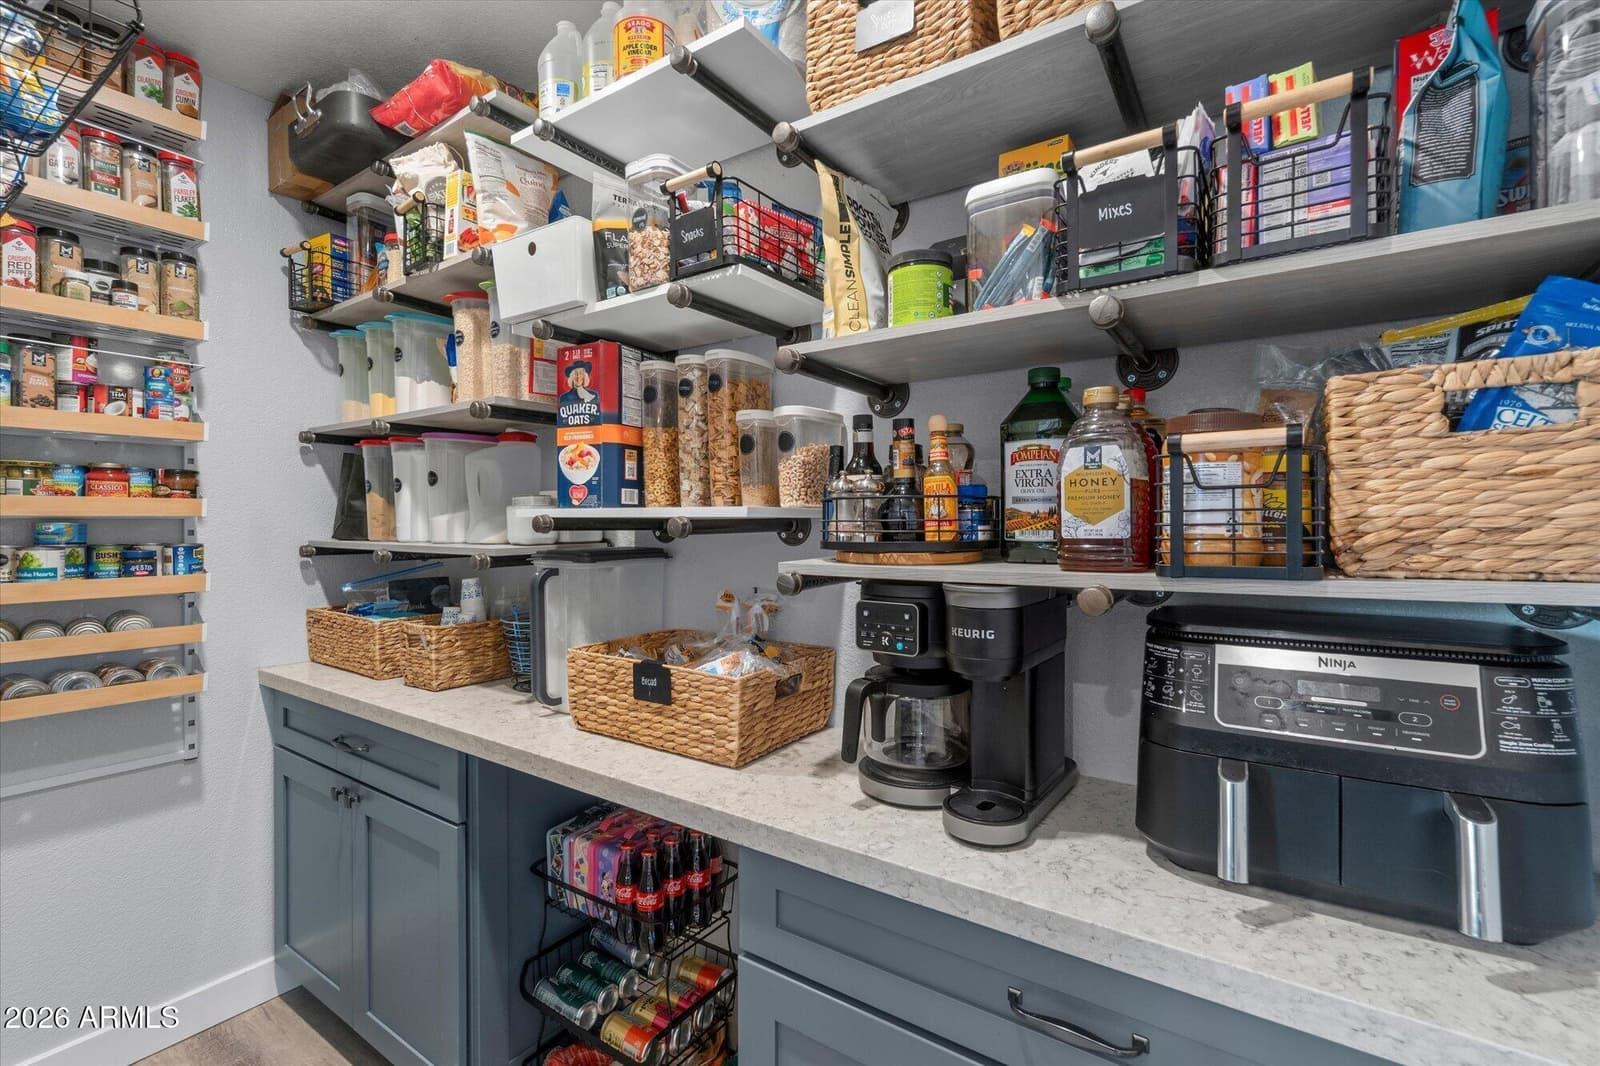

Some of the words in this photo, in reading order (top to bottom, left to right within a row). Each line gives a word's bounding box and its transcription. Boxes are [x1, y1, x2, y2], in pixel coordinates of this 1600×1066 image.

[622, 43, 639, 52] APPLE
[175, 94, 197, 107] CUMIN
[1098, 202, 1133, 222] Mixes
[680, 226, 705, 244] Snacks
[7, 261, 33, 270] RED
[7, 268, 33, 279] PEPPER
[560, 403, 600, 418] QUAKER
[568, 414, 590, 425] OATS
[1011, 448, 1058, 463] POMPEIAN
[1015, 468, 1053, 480] EXTRA
[1013, 478, 1054, 488] VIRGIN
[1069, 477, 1118, 488] HONEY
[951, 627, 996, 640] KEURIG
